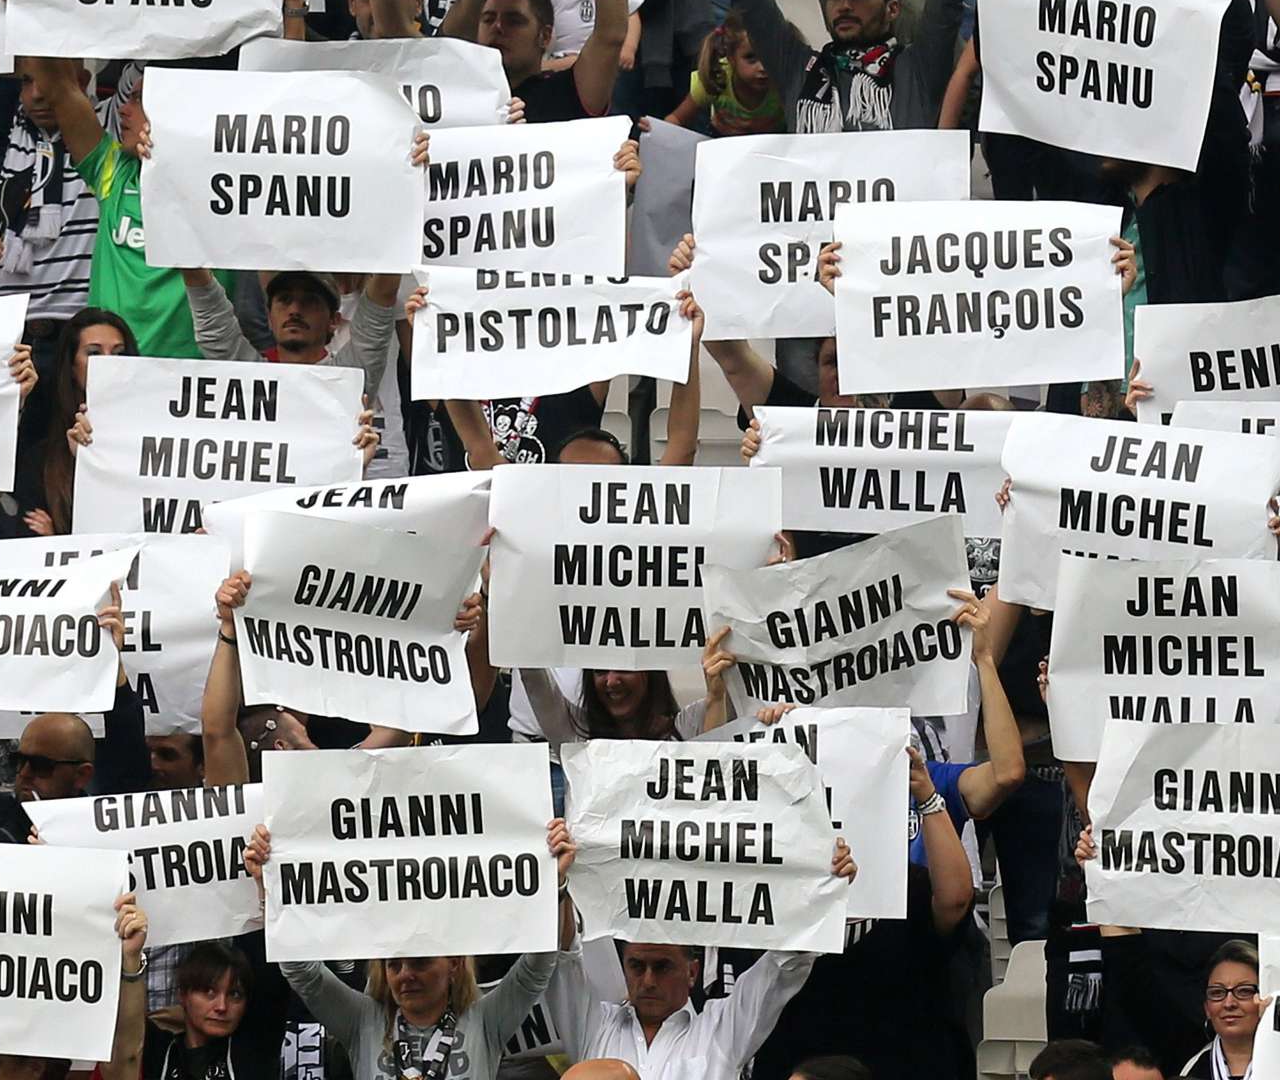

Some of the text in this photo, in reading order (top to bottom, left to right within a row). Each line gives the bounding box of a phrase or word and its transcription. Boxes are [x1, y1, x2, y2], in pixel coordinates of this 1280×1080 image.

[209, 172, 351, 218] SPANU
[427, 151, 555, 202] MARIO
[880, 227, 1073, 279] JACQUES
[436, 301, 671, 353] PISTOLATO
[872, 286, 1084, 338] FRANÇOIS
[168, 376, 278, 422] JEAN
[139, 436, 296, 484] MICHEL
[1090, 435, 1203, 483] JEAN
[579, 481, 691, 525] JEAN
[819, 466, 967, 514] WALLA
[243, 616, 452, 685] MASTROIACO
[736, 614, 965, 709] MASTROIACO
[1103, 634, 1265, 677] MICHEL
[330, 792, 484, 841] GIANNI
[619, 819, 784, 865] MICHEL
[279, 853, 540, 906] MASTROIACO
[624, 878, 775, 926] WALLA
